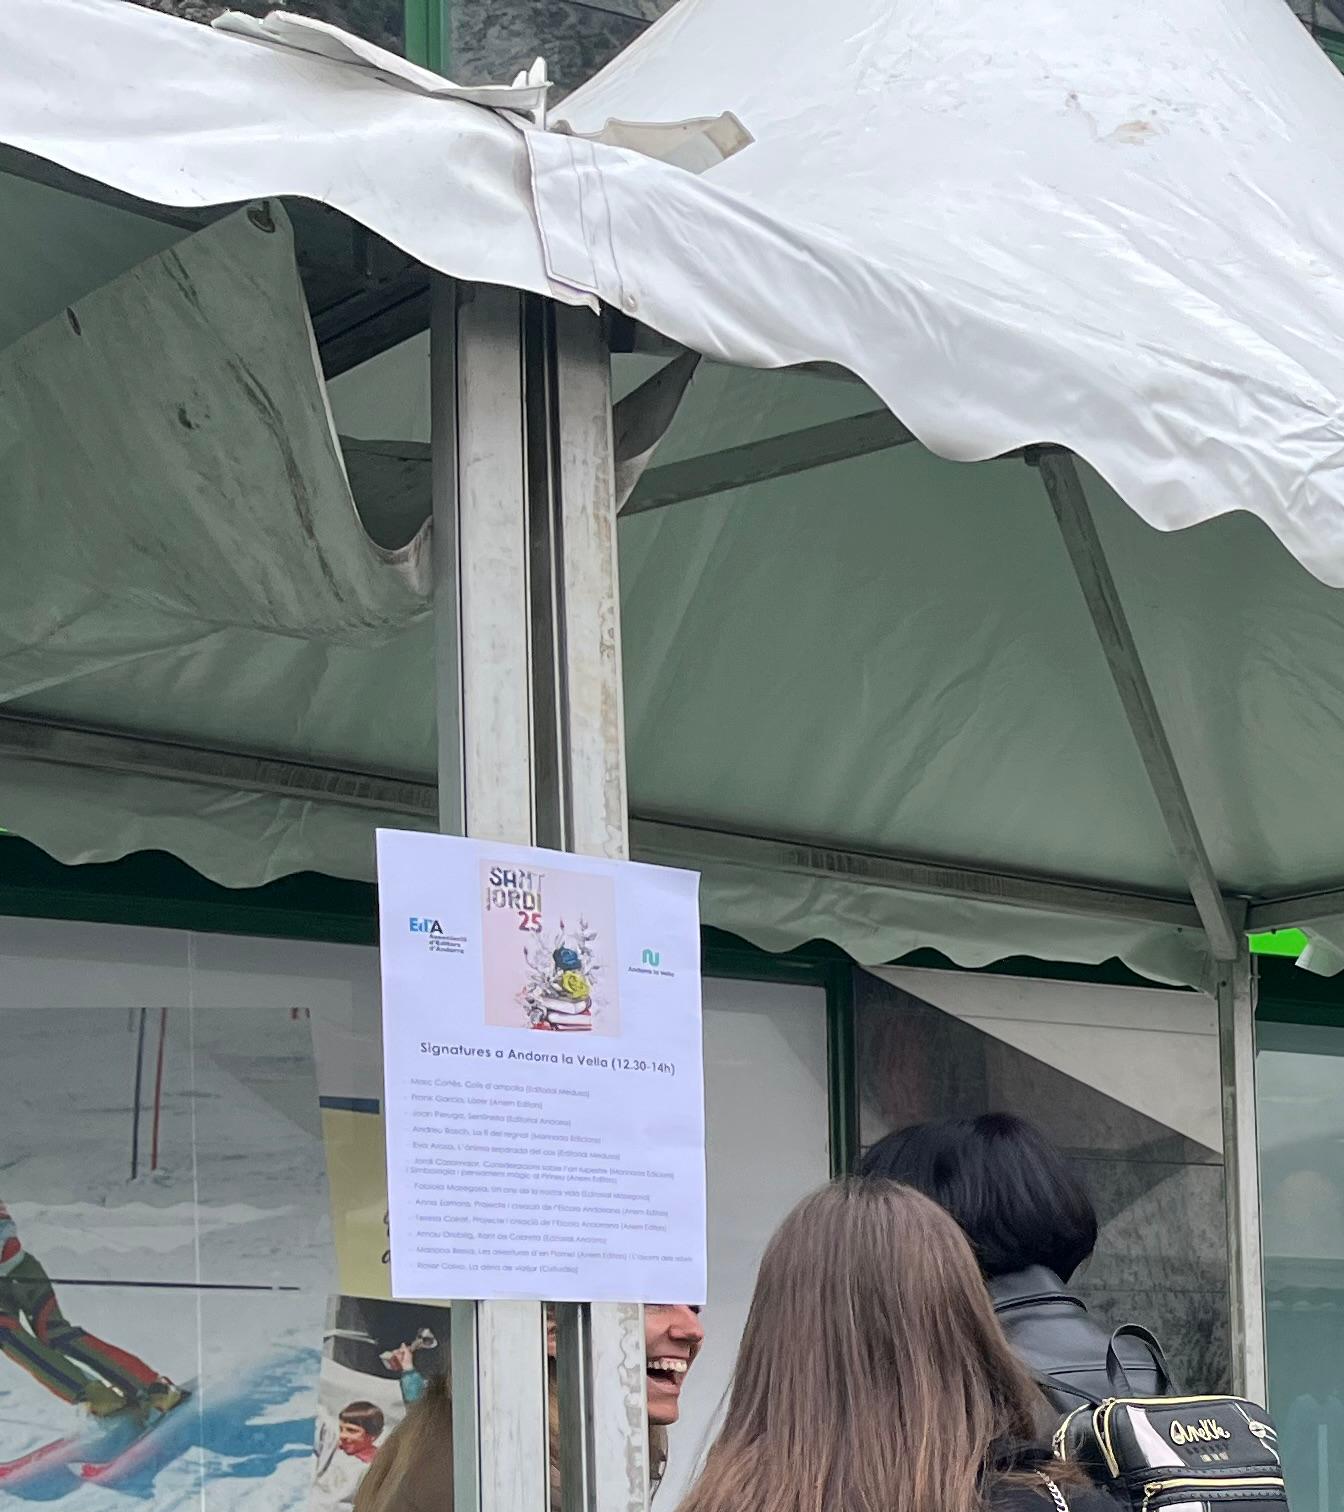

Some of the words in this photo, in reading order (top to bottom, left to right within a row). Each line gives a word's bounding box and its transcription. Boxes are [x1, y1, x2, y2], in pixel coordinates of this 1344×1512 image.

[486, 887, 542, 913] JORDI
[519, 911, 543, 934] 25
[420, 1041, 492, 1058] Signatures
[495, 1050, 504, 1059] a
[508, 1049, 559, 1064] Andorra
[561, 1054, 574, 1065] la
[577, 1055, 609, 1068] Vella
[611, 1057, 676, 1076] (12.30-14h)
